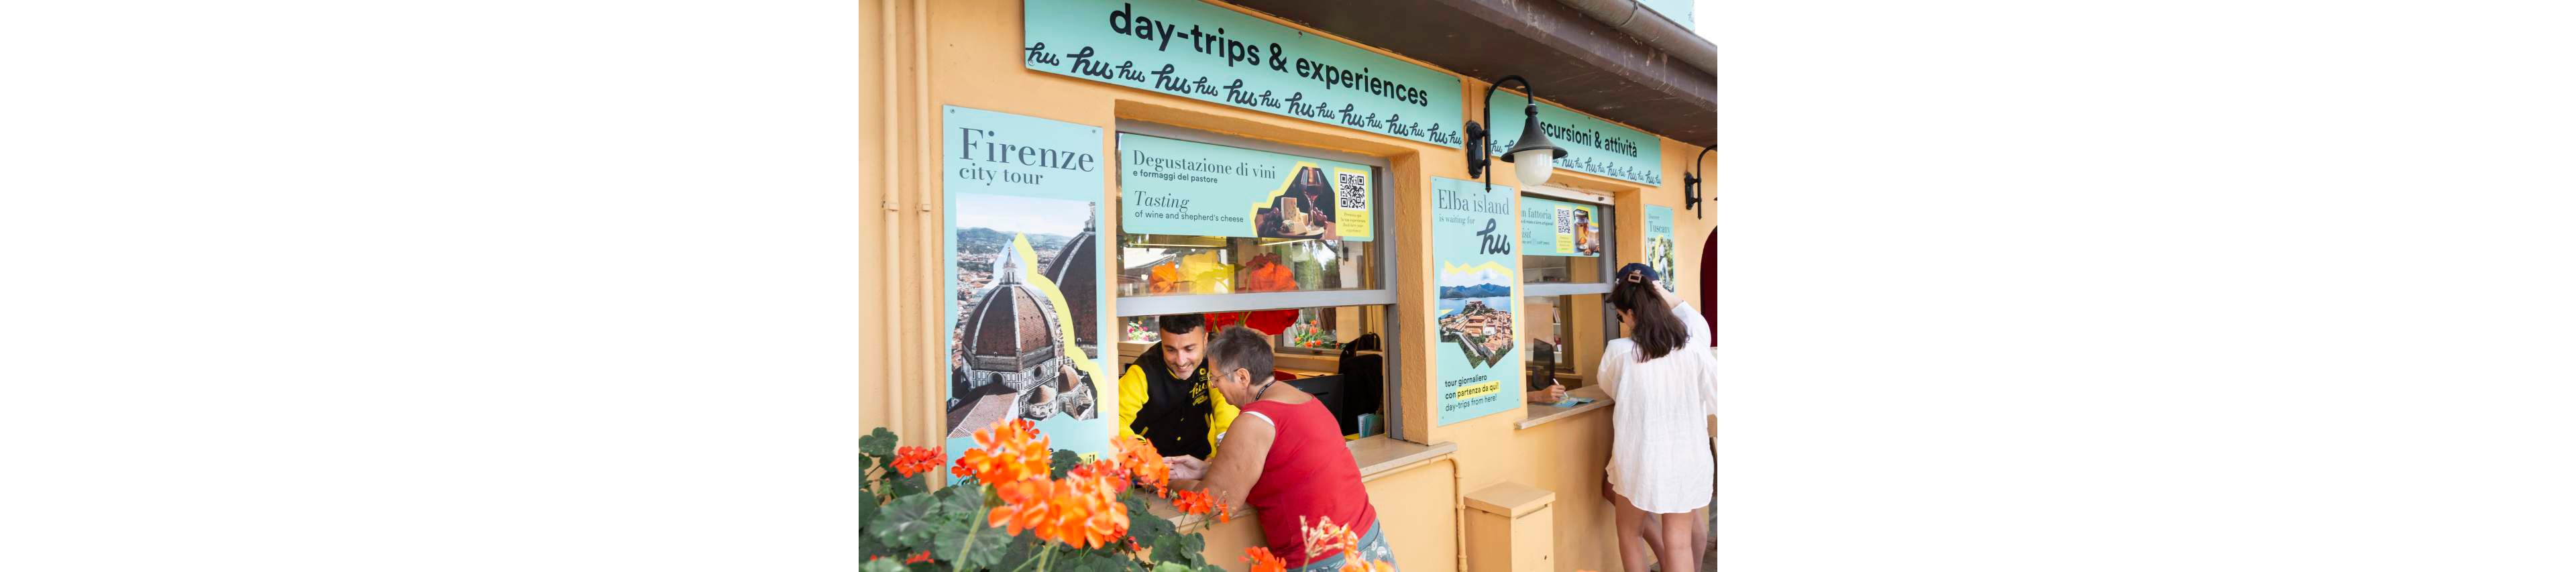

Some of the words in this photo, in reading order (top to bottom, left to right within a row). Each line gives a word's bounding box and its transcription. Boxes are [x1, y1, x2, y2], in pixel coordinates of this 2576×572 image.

[1110, 2, 1260, 67] day-trips
[1269, 42, 1288, 73] &
[1295, 58, 1428, 107] experiences
[1025, 42, 1059, 66] hu
[1067, 46, 1114, 80] hu
[1116, 60, 1145, 82] hu
[1151, 64, 1191, 94] hu
[1193, 76, 1218, 97] hu
[1224, 78, 1257, 107] hu
[1258, 90, 1281, 109] hu
[1285, 92, 1315, 118] hu
[1316, 102, 1335, 119] hu
[1338, 103, 1364, 128] hu
[1366, 113, 1383, 129] hu
[1385, 113, 1409, 136] hu
[1409, 122, 1425, 137] hu
[1428, 123, 1448, 144] hu
[1448, 131, 1462, 145] hu
[959, 127, 1095, 172] Firenze
[1540, 121, 1591, 147] scursioni
[1595, 131, 1603, 150] &
[1605, 134, 1638, 158] attività
[959, 163, 997, 186] city
[1003, 169, 1043, 184] tour
[1133, 150, 1232, 175] Degustazione
[1236, 162, 1248, 176] di
[1252, 164, 1276, 179] vini
[1585, 156, 1597, 172] hu
[1607, 162, 1618, 177] hu
[1627, 166, 1637, 180] hu
[1140, 170, 1175, 180] formaggi
[1177, 173, 1189, 181] del
[1191, 175, 1218, 184] pastore
[1134, 190, 1189, 213] Tasting
[1438, 188, 1469, 211] Elba
[1473, 193, 1509, 215] island
[1528, 207, 1551, 219] fattoria
[1181, 213, 1219, 221] shepherd's
[1220, 215, 1244, 223] cheese
[1446, 215, 1466, 225] waiting
[1467, 216, 1475, 225] for
[1477, 218, 1510, 255] hu
[1521, 227, 1532, 239] isit
[1457, 386, 1481, 399] partenza
[1482, 384, 1489, 392] da
[1489, 382, 1499, 391] qui!
[1458, 374, 1487, 387] giornaliero
[1445, 400, 1470, 412] day-trips
[1471, 398, 1483, 406] from
[1485, 394, 1497, 403] here!
